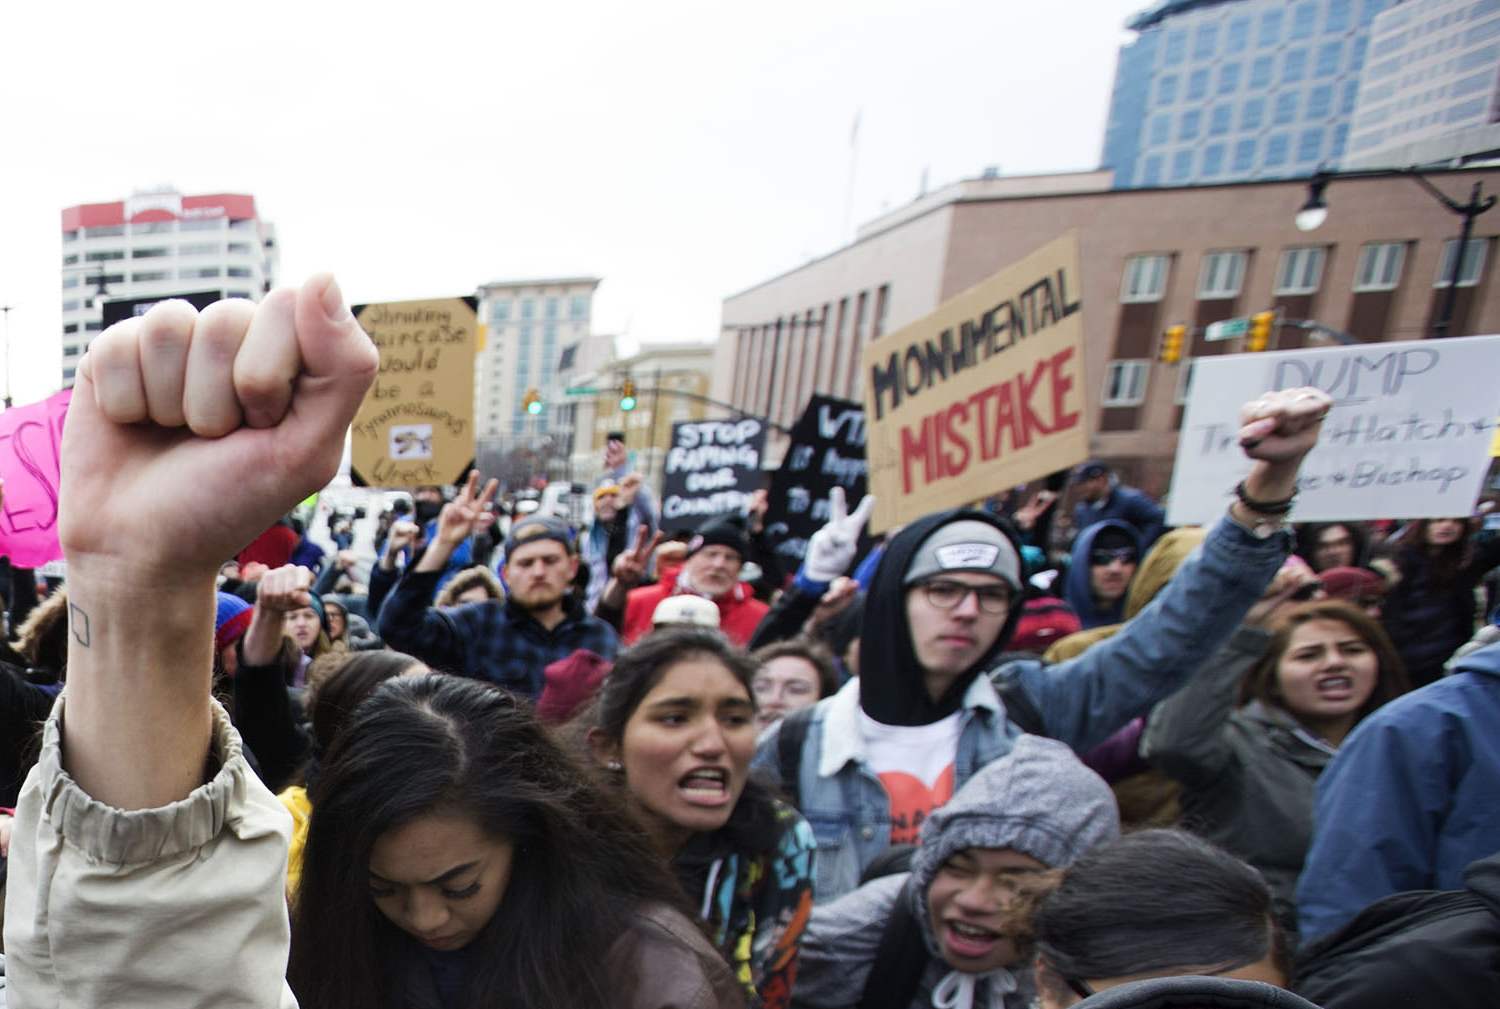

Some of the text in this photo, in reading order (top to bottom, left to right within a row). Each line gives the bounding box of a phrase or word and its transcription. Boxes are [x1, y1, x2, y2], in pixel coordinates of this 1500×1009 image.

[872, 267, 1082, 422] MONUMENTAL
[1272, 347, 1440, 396] DUMP
[677, 419, 762, 449] STOP
[901, 346, 1080, 496] MISTAKE
